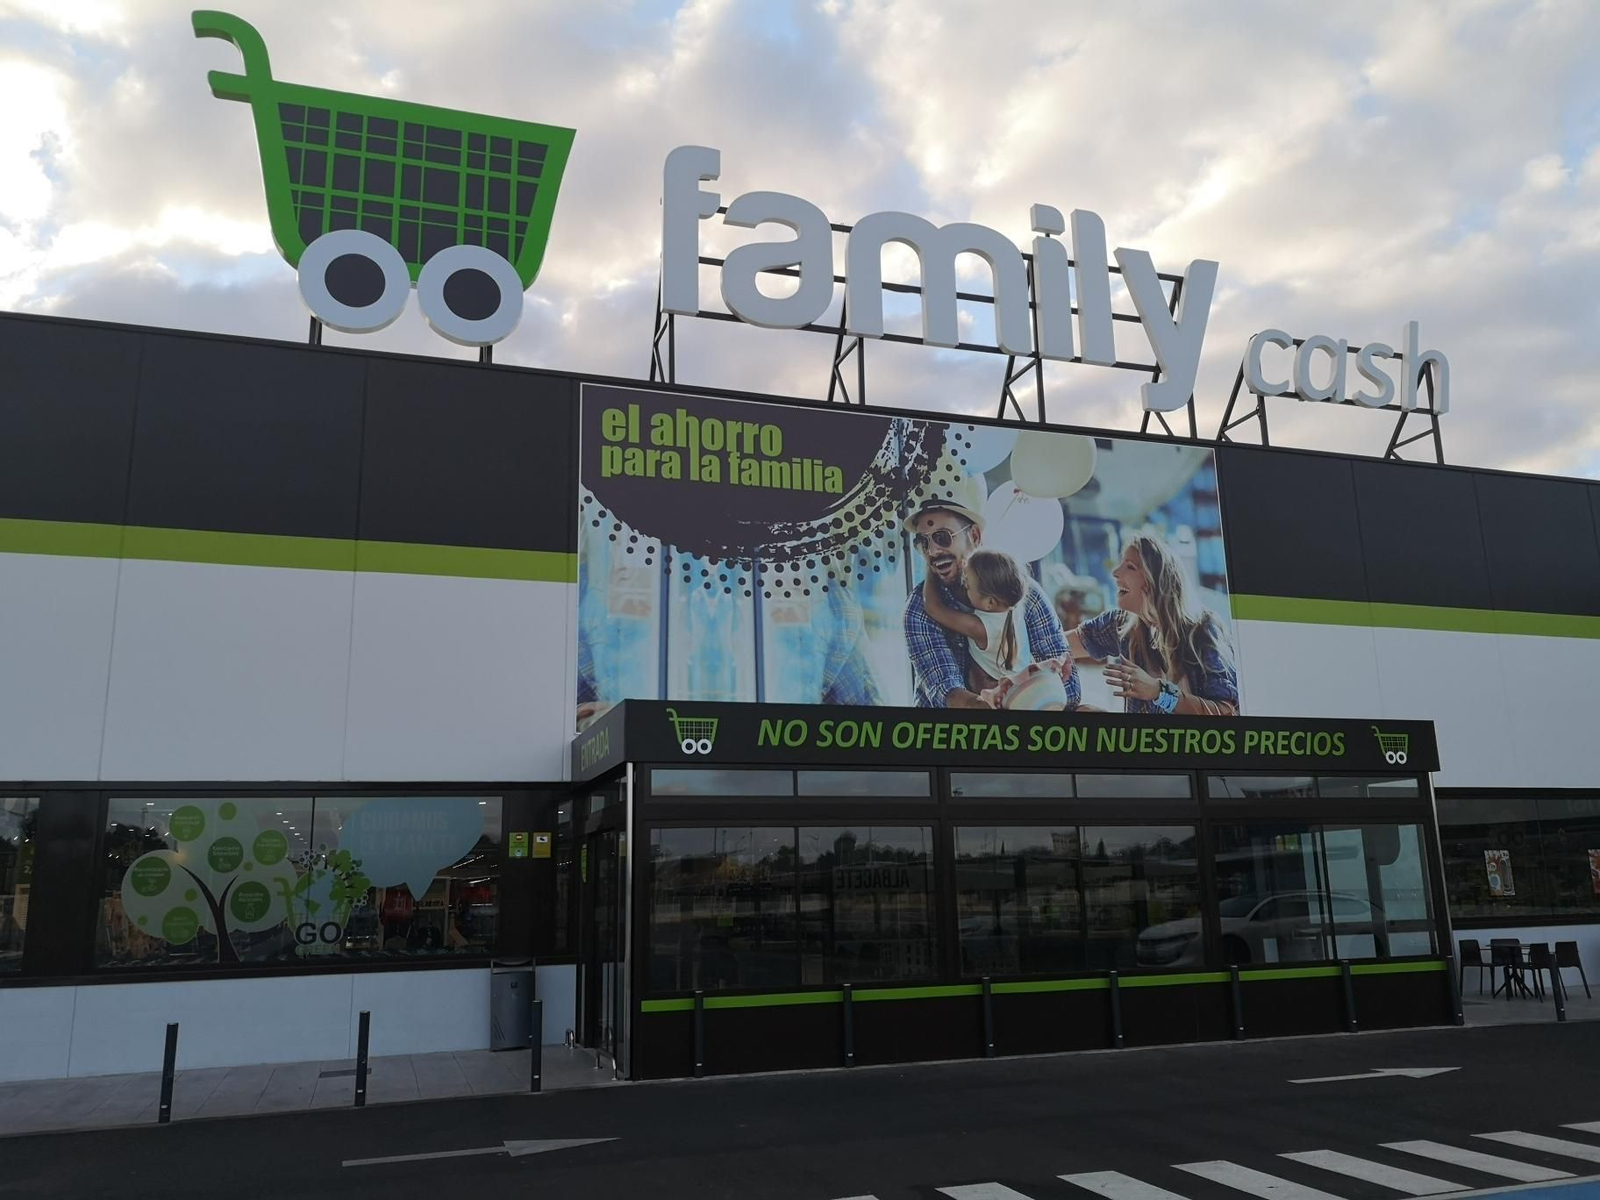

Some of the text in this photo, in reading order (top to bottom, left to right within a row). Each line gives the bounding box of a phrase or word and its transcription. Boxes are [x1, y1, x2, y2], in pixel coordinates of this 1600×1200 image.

[662, 145, 1449, 415] family cash
[602, 404, 782, 457] el ahorro
[602, 445, 843, 494] para la familia
[581, 727, 610, 772] ENTRADA
[758, 719, 1345, 756] NO SON OFERTAS SON NUESTROS PRECIOS
[296, 921, 342, 944] GO
